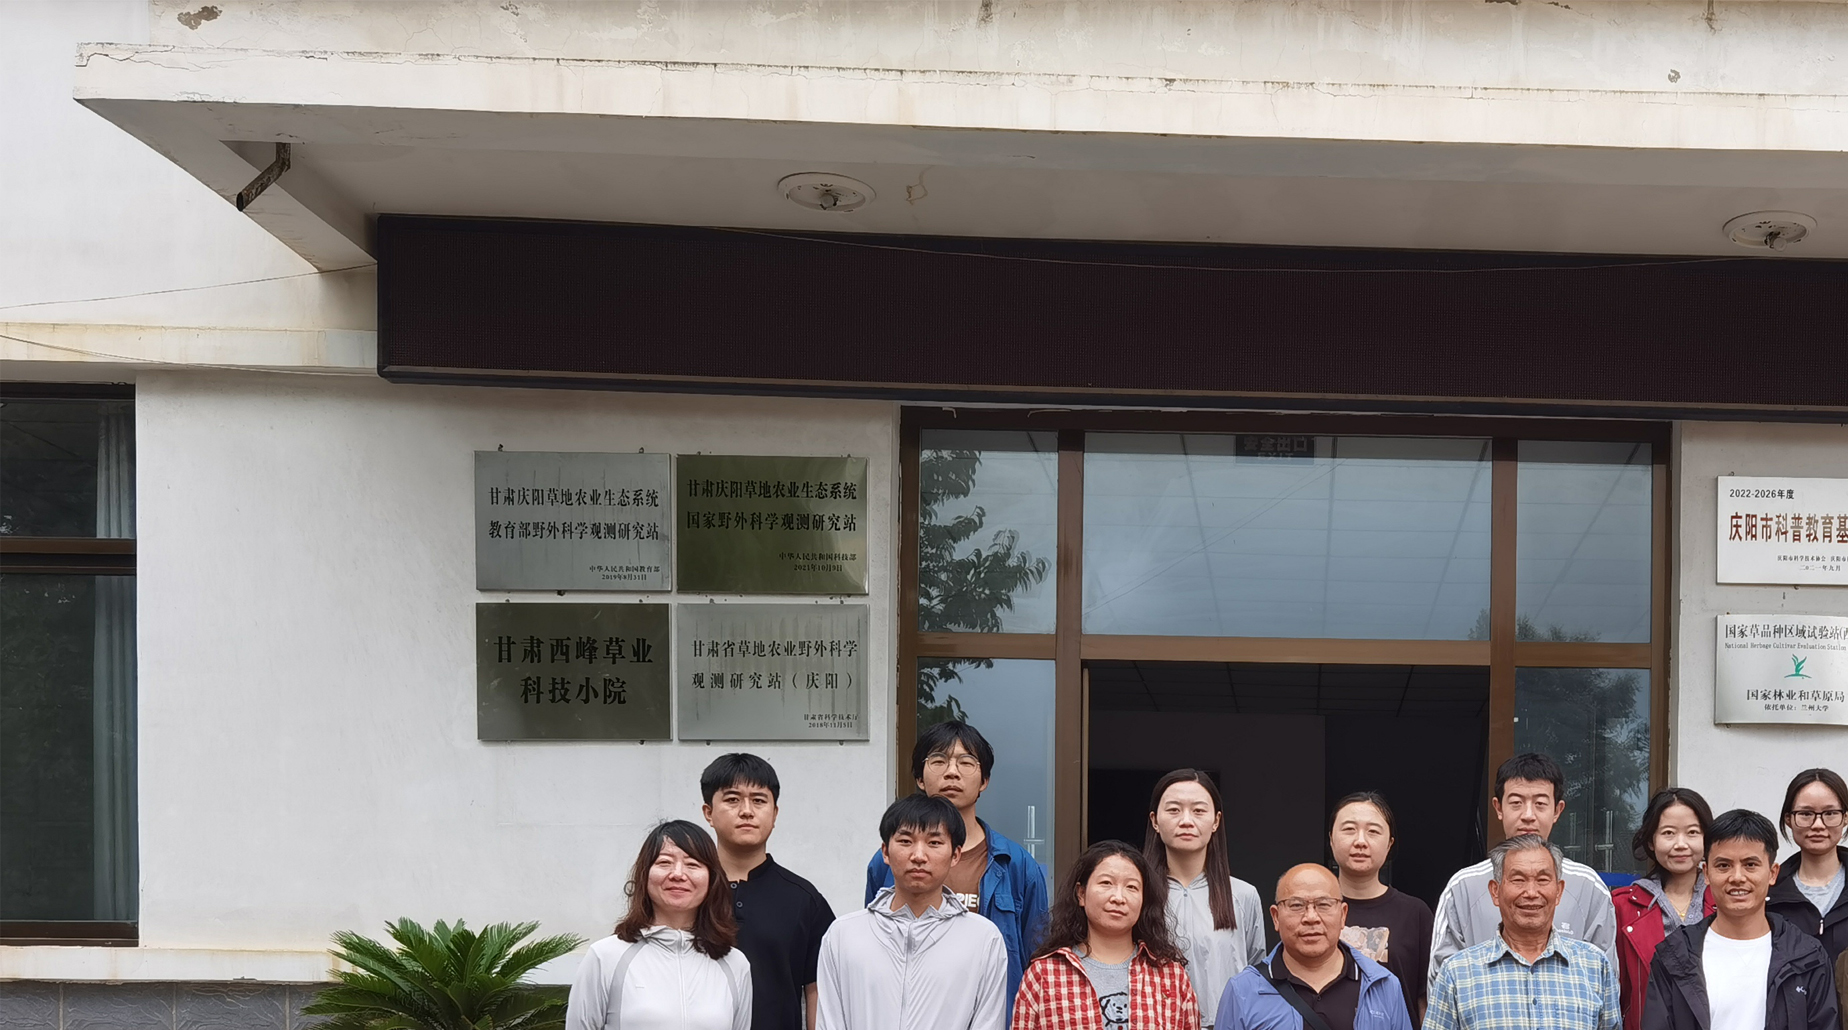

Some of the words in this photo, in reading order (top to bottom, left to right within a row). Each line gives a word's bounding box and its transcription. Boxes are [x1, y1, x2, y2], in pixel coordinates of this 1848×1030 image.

[488, 487, 659, 507] 甘肃庆阳草地农业生态系统
[687, 479, 857, 500] 甘肃庆阳草地农业生态系统
[1729, 489, 1795, 500] 2022-2026年度
[488, 520, 659, 541] 教育部野外科学观测研究站
[687, 511, 857, 531] 国家野外科学观测研究站
[778, 553, 857, 561] 中华人民共和国科技部
[589, 565, 661, 573] 中华人民共和国教育部
[493, 635, 653, 664] 甘肃西峰草业
[691, 640, 858, 658] 甘肃省草地农业野外科学
[520, 676, 627, 705] 科技小院
[1746, 689, 1845, 702] 国家林业和草原局
